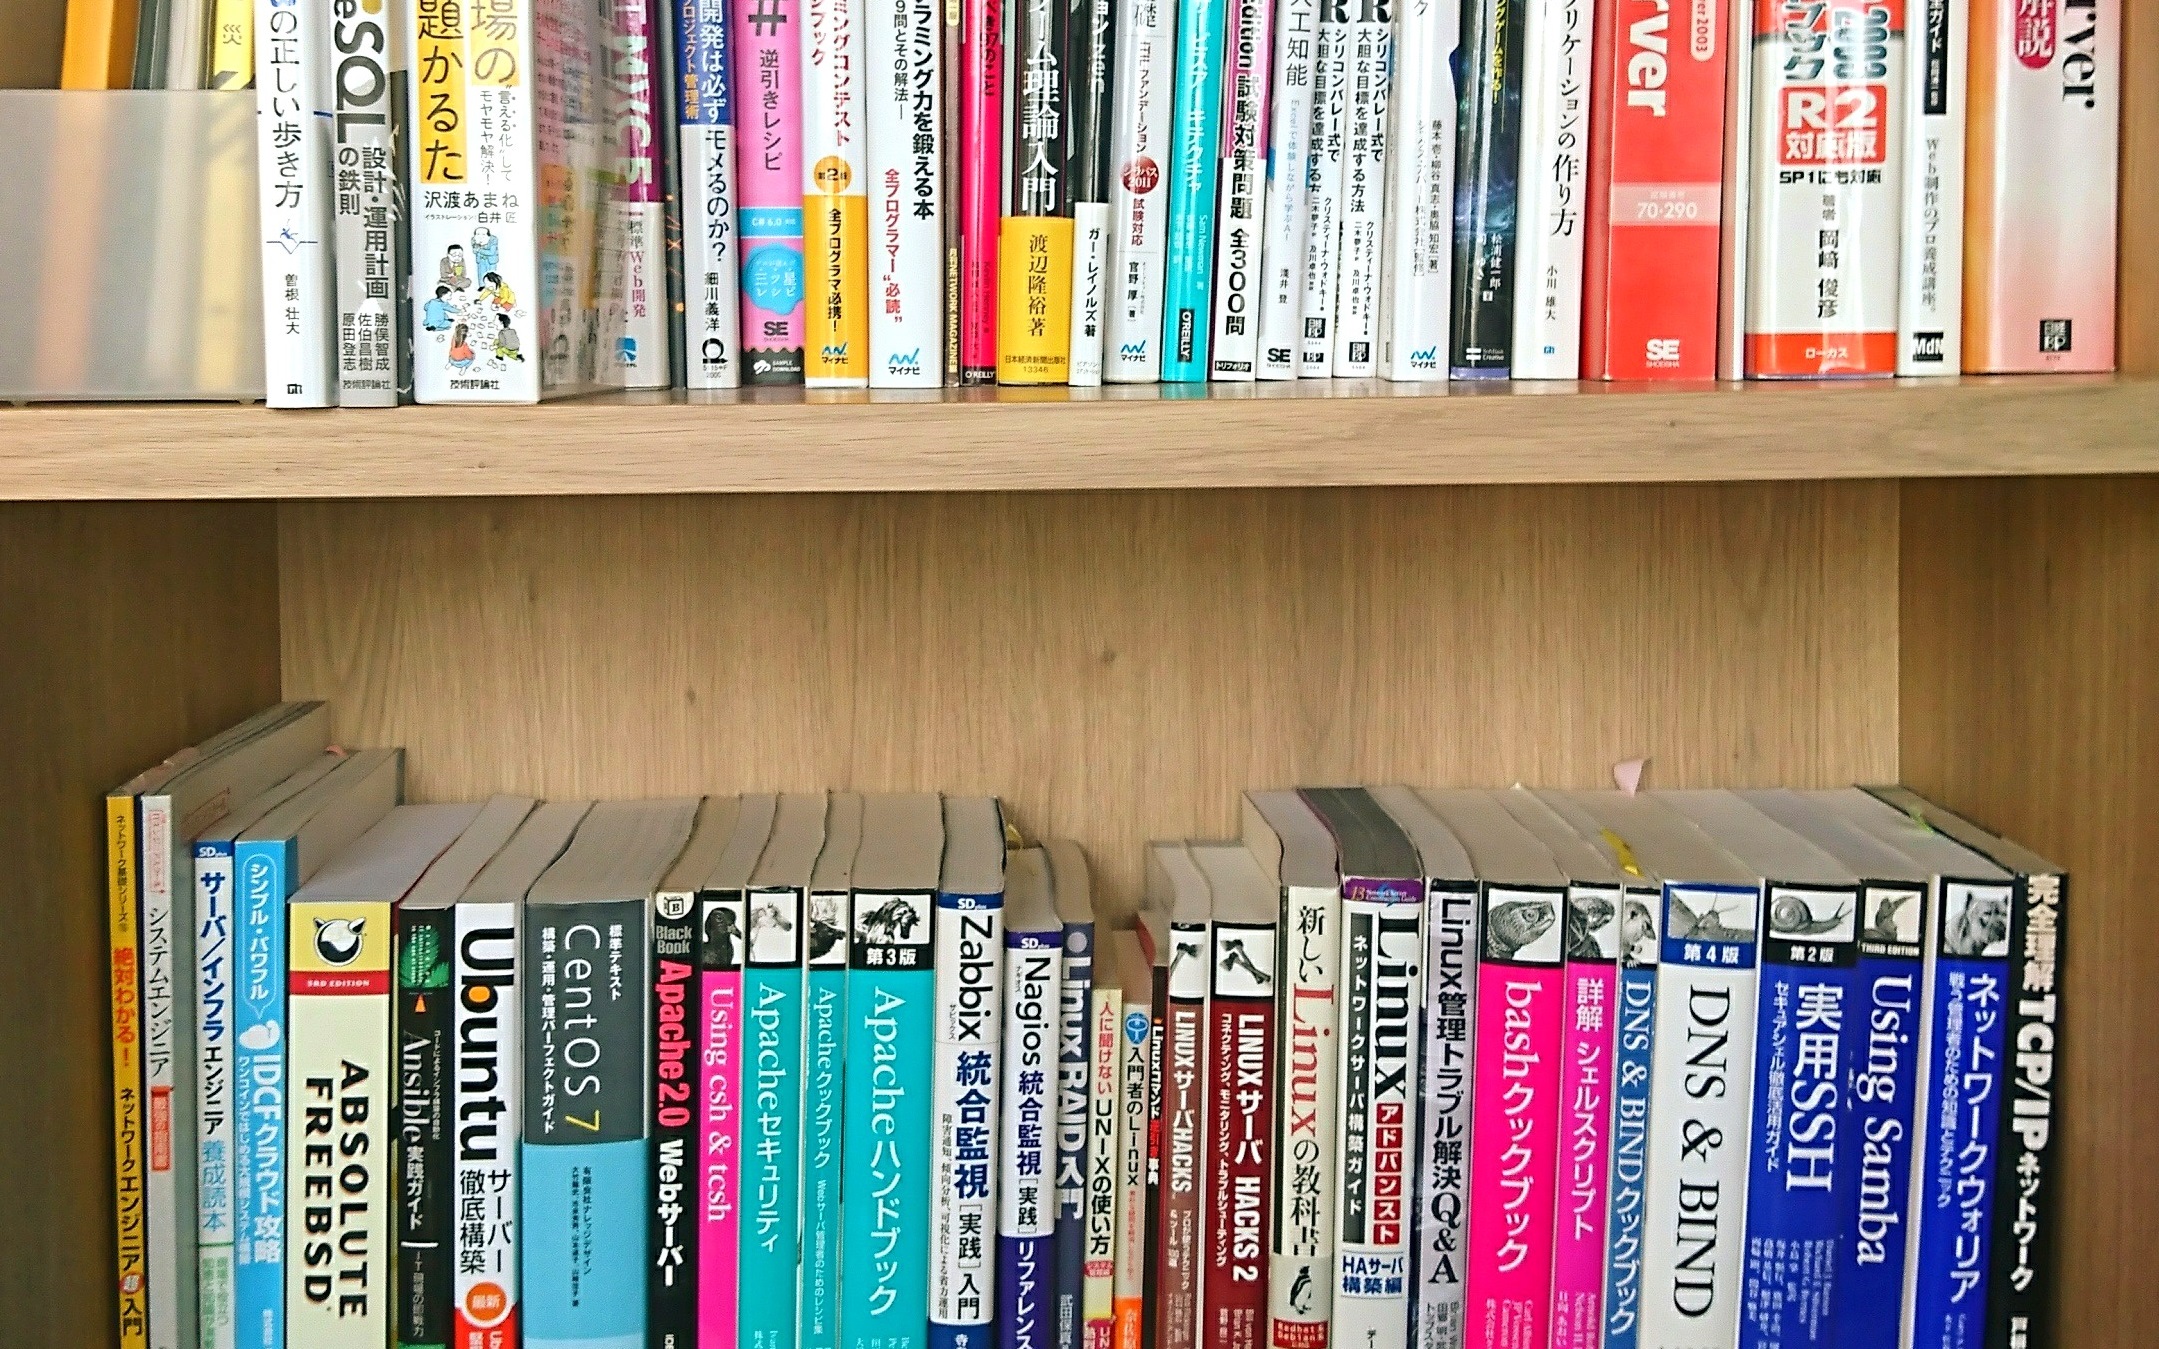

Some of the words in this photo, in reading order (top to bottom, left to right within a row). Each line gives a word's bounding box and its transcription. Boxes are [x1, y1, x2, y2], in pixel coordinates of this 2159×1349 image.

[1695, 18, 1709, 53] 2003
[419, 0, 466, 181] 題かるた
[760, 49, 782, 171] 逆引きレシピ
[1328, 28, 1347, 162] シリコンバレー式で
[1351, 28, 1370, 213] 大胆な目標を達成する方法
[1371, 28, 1389, 162] シリコンバレー式で
[1787, 91, 1877, 131] R2
[1231, 76, 1258, 218] 試験対策問題
[1786, 132, 1876, 159] 対応版
[339, 146, 360, 216] の鉄則
[1128, 177, 1151, 188] 2011
[362, 146, 389, 299] 設計・運用計画
[1132, 198, 1145, 246] 試験対応
[628, 220, 647, 318] 標準Web開発
[704, 272, 720, 331] 細川義洋
[756, 287, 795, 297] レシピ
[828, 209, 842, 331] 全プログラマ必携!
[342, 313, 358, 371] 原田登志
[358, 313, 373, 371] 佐伯昌樹
[374, 313, 390, 371] 勝俣智成
[764, 321, 789, 335] SE
[822, 356, 848, 364] マイナビ
[1005, 356, 1066, 365] 日本経済新聞出版社
[1181, 310, 1192, 360] O'REILLY
[1267, 349, 1291, 362] SE
[1646, 339, 1680, 360] SE
[1914, 338, 1943, 354] MdN
[342, 379, 392, 389] 技術評論社
[451, 379, 500, 390] 技術評論社
[889, 365, 920, 375] マイナビ
[250, 863, 269, 1000] シンプル・パワフル
[610, 924, 622, 1000] 標準テキスト
[657, 926, 692, 939] Black
[657, 940, 690, 954] Book
[866, 948, 916, 965] 第3版
[1684, 944, 1738, 964] 第4版
[1790, 946, 1834, 963] 第2版
[148, 908, 171, 1076] システムエンジニア
[329, 979, 370, 988] EDITION
[565, 924, 600, 1096] CentOS
[958, 915, 993, 1041] Zabbix
[1016, 957, 1050, 1066] Nagios
[1060, 957, 1092, 1057] Linux
[1375, 911, 1419, 1100] Linux
[1576, 978, 1604, 1032] 詳解
[460, 927, 515, 1161] Ubuntu
[705, 987, 733, 1066] Using
[1624, 980, 1651, 1051] DNS
[1685, 984, 1730, 1099] DNS
[1857, 974, 1912, 1103] Using
[708, 1075, 733, 1121] csh
[1349, 936, 1368, 1215] ネットワークサーバ構築ガイド
[1621, 1061, 1647, 1087] &
[1787, 983, 1843, 1192] 実用SSH
[565, 1110, 600, 1131] 7
[709, 1132, 732, 1155] &
[1572, 1042, 1601, 1241] シェルスクリプト
[1681, 1119, 1723, 1163] &
[1951, 973, 2000, 1303] ネットワークウォリア
[252, 1055, 282, 1263] IDCFクラウド攻略
[304, 1078, 334, 1304] FREEBSD
[339, 1060, 369, 1318] ABSOLUTE
[708, 1164, 732, 1221] tcsh
[1376, 1105, 1402, 1243] アドバンスト
[1857, 1116, 1903, 1266] Samba
[460, 1169, 485, 1274] 徹底構築
[488, 1169, 511, 1273] サーバー
[657, 1139, 684, 1286] Webサーバー
[1233, 1176, 1260, 1259] HACKS
[1233, 1267, 1258, 1281] 2
[1343, 1255, 1403, 1274] HAサーバ
[1673, 1178, 1719, 1318] BIND
[1343, 1276, 1402, 1294] 構築編
